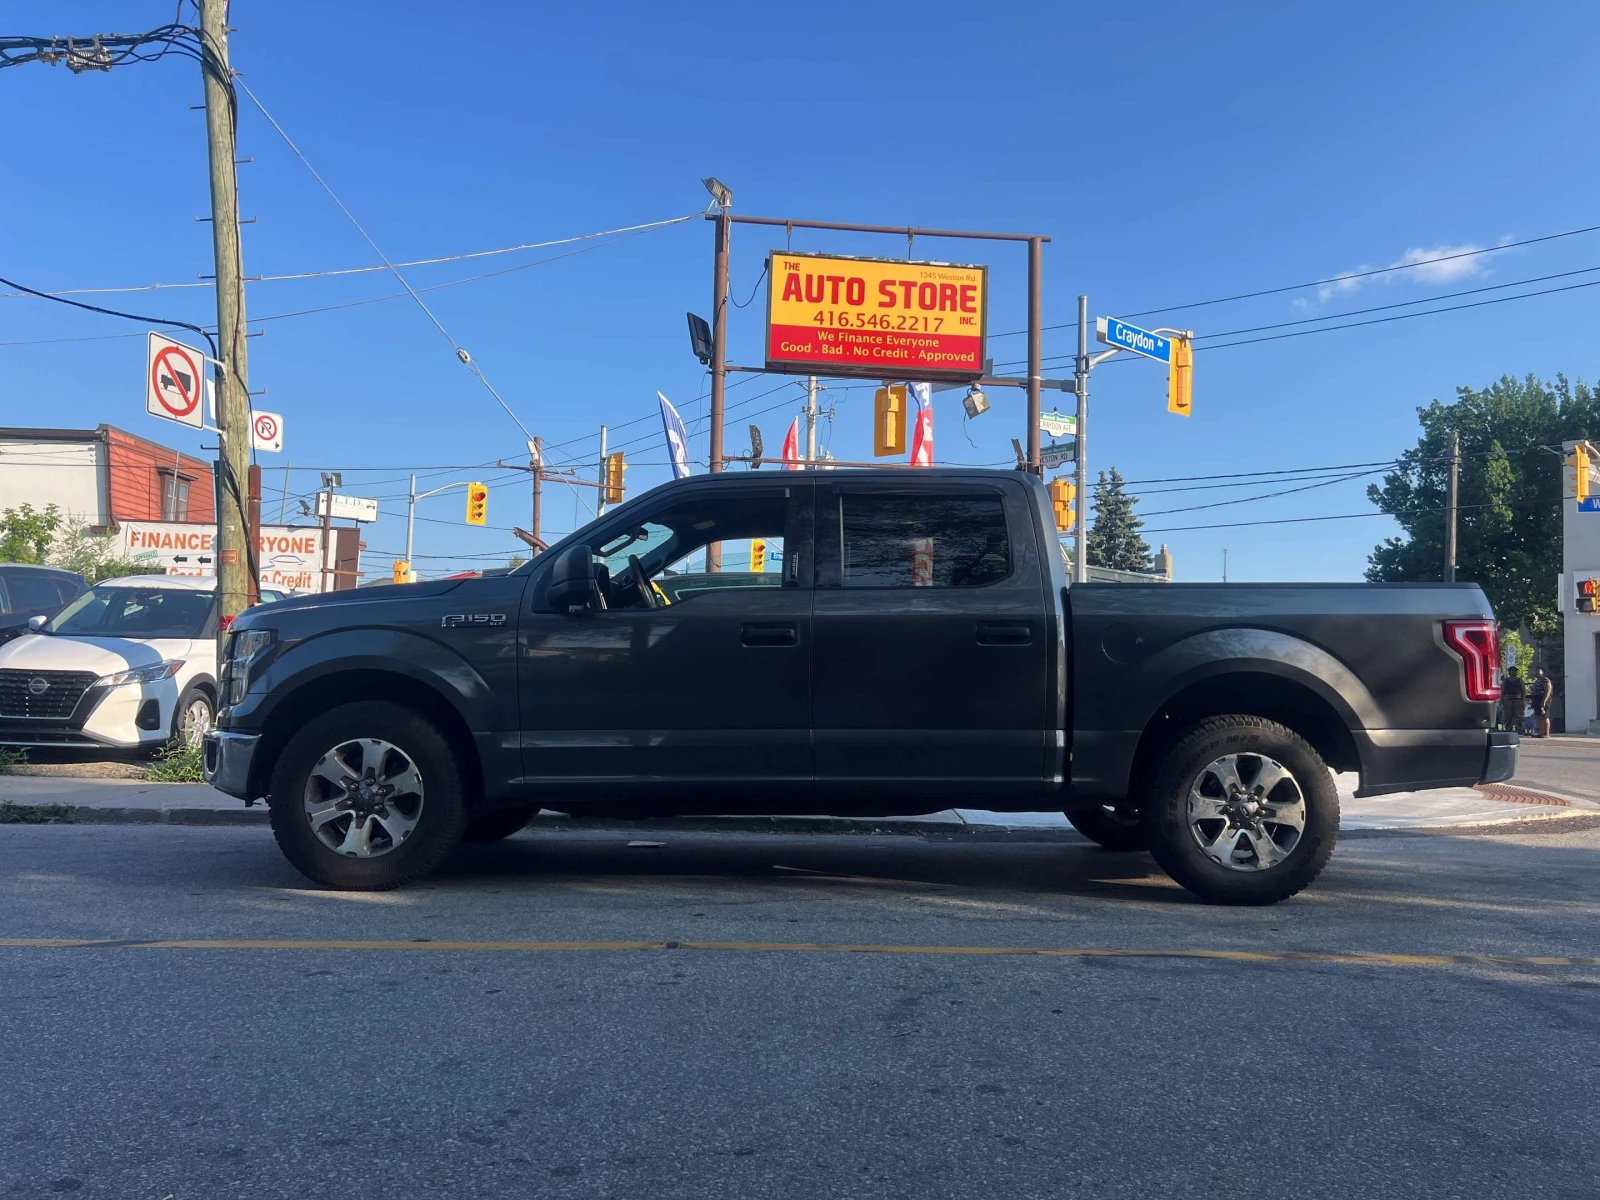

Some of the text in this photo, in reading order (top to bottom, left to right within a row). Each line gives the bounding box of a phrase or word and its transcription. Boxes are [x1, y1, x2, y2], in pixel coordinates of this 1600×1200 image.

[783, 261, 801, 271] THE
[920, 271, 937, 279] 1345
[938, 273, 964, 281] Weston
[782, 272, 977, 313] AUTO STORE
[813, 310, 944, 332] 416.546.2217
[959, 316, 977, 326] INC.
[817, 331, 939, 348] We Finance Everyone
[1115, 323, 1154, 352] Craydon
[780, 341, 812, 353] Good
[822, 344, 843, 355] Bad
[853, 347, 869, 356] No
[872, 347, 909, 359] Credit
[918, 350, 975, 362] Approved
[130, 531, 211, 550] FINANCE
[272, 570, 312, 589] Credit
